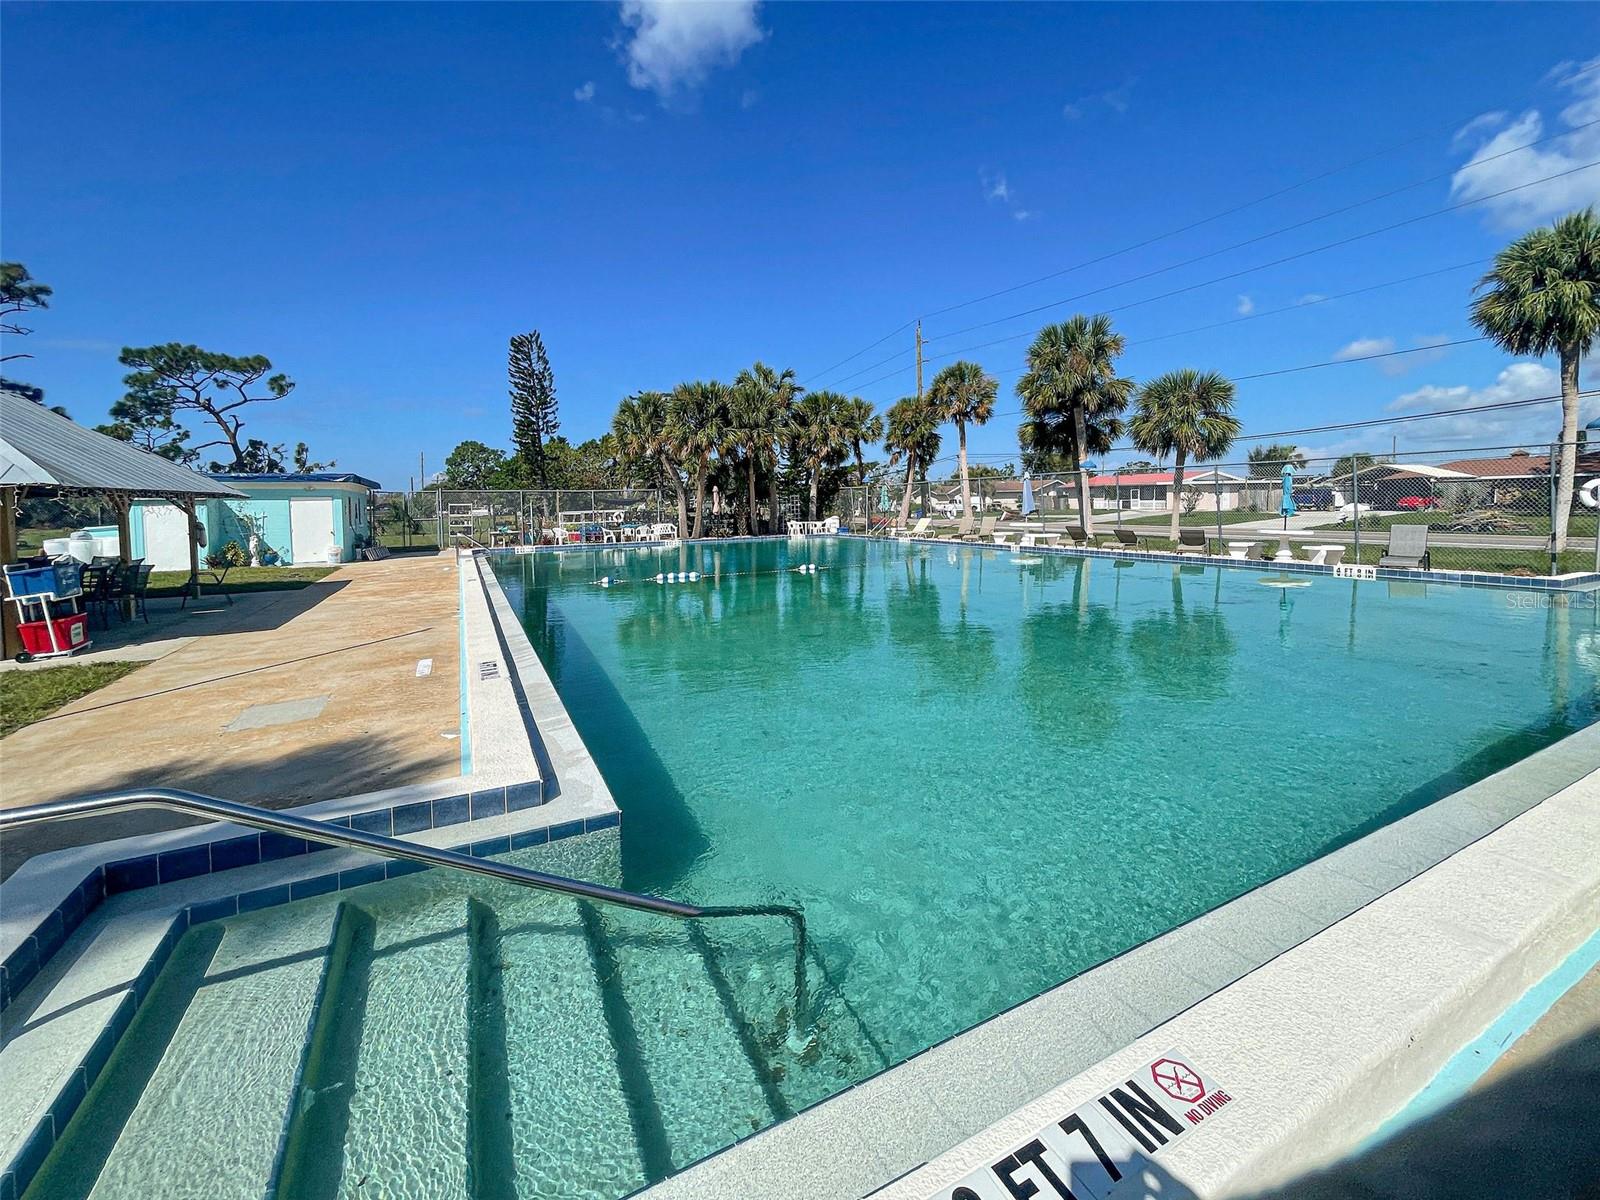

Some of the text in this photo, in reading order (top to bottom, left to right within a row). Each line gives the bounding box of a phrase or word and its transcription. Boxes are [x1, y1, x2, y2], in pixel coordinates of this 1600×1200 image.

[991, 1079, 1186, 1200] FT 7 IN
[1184, 1108, 1204, 1125] NO
[1197, 1090, 1232, 1116] DIVING
